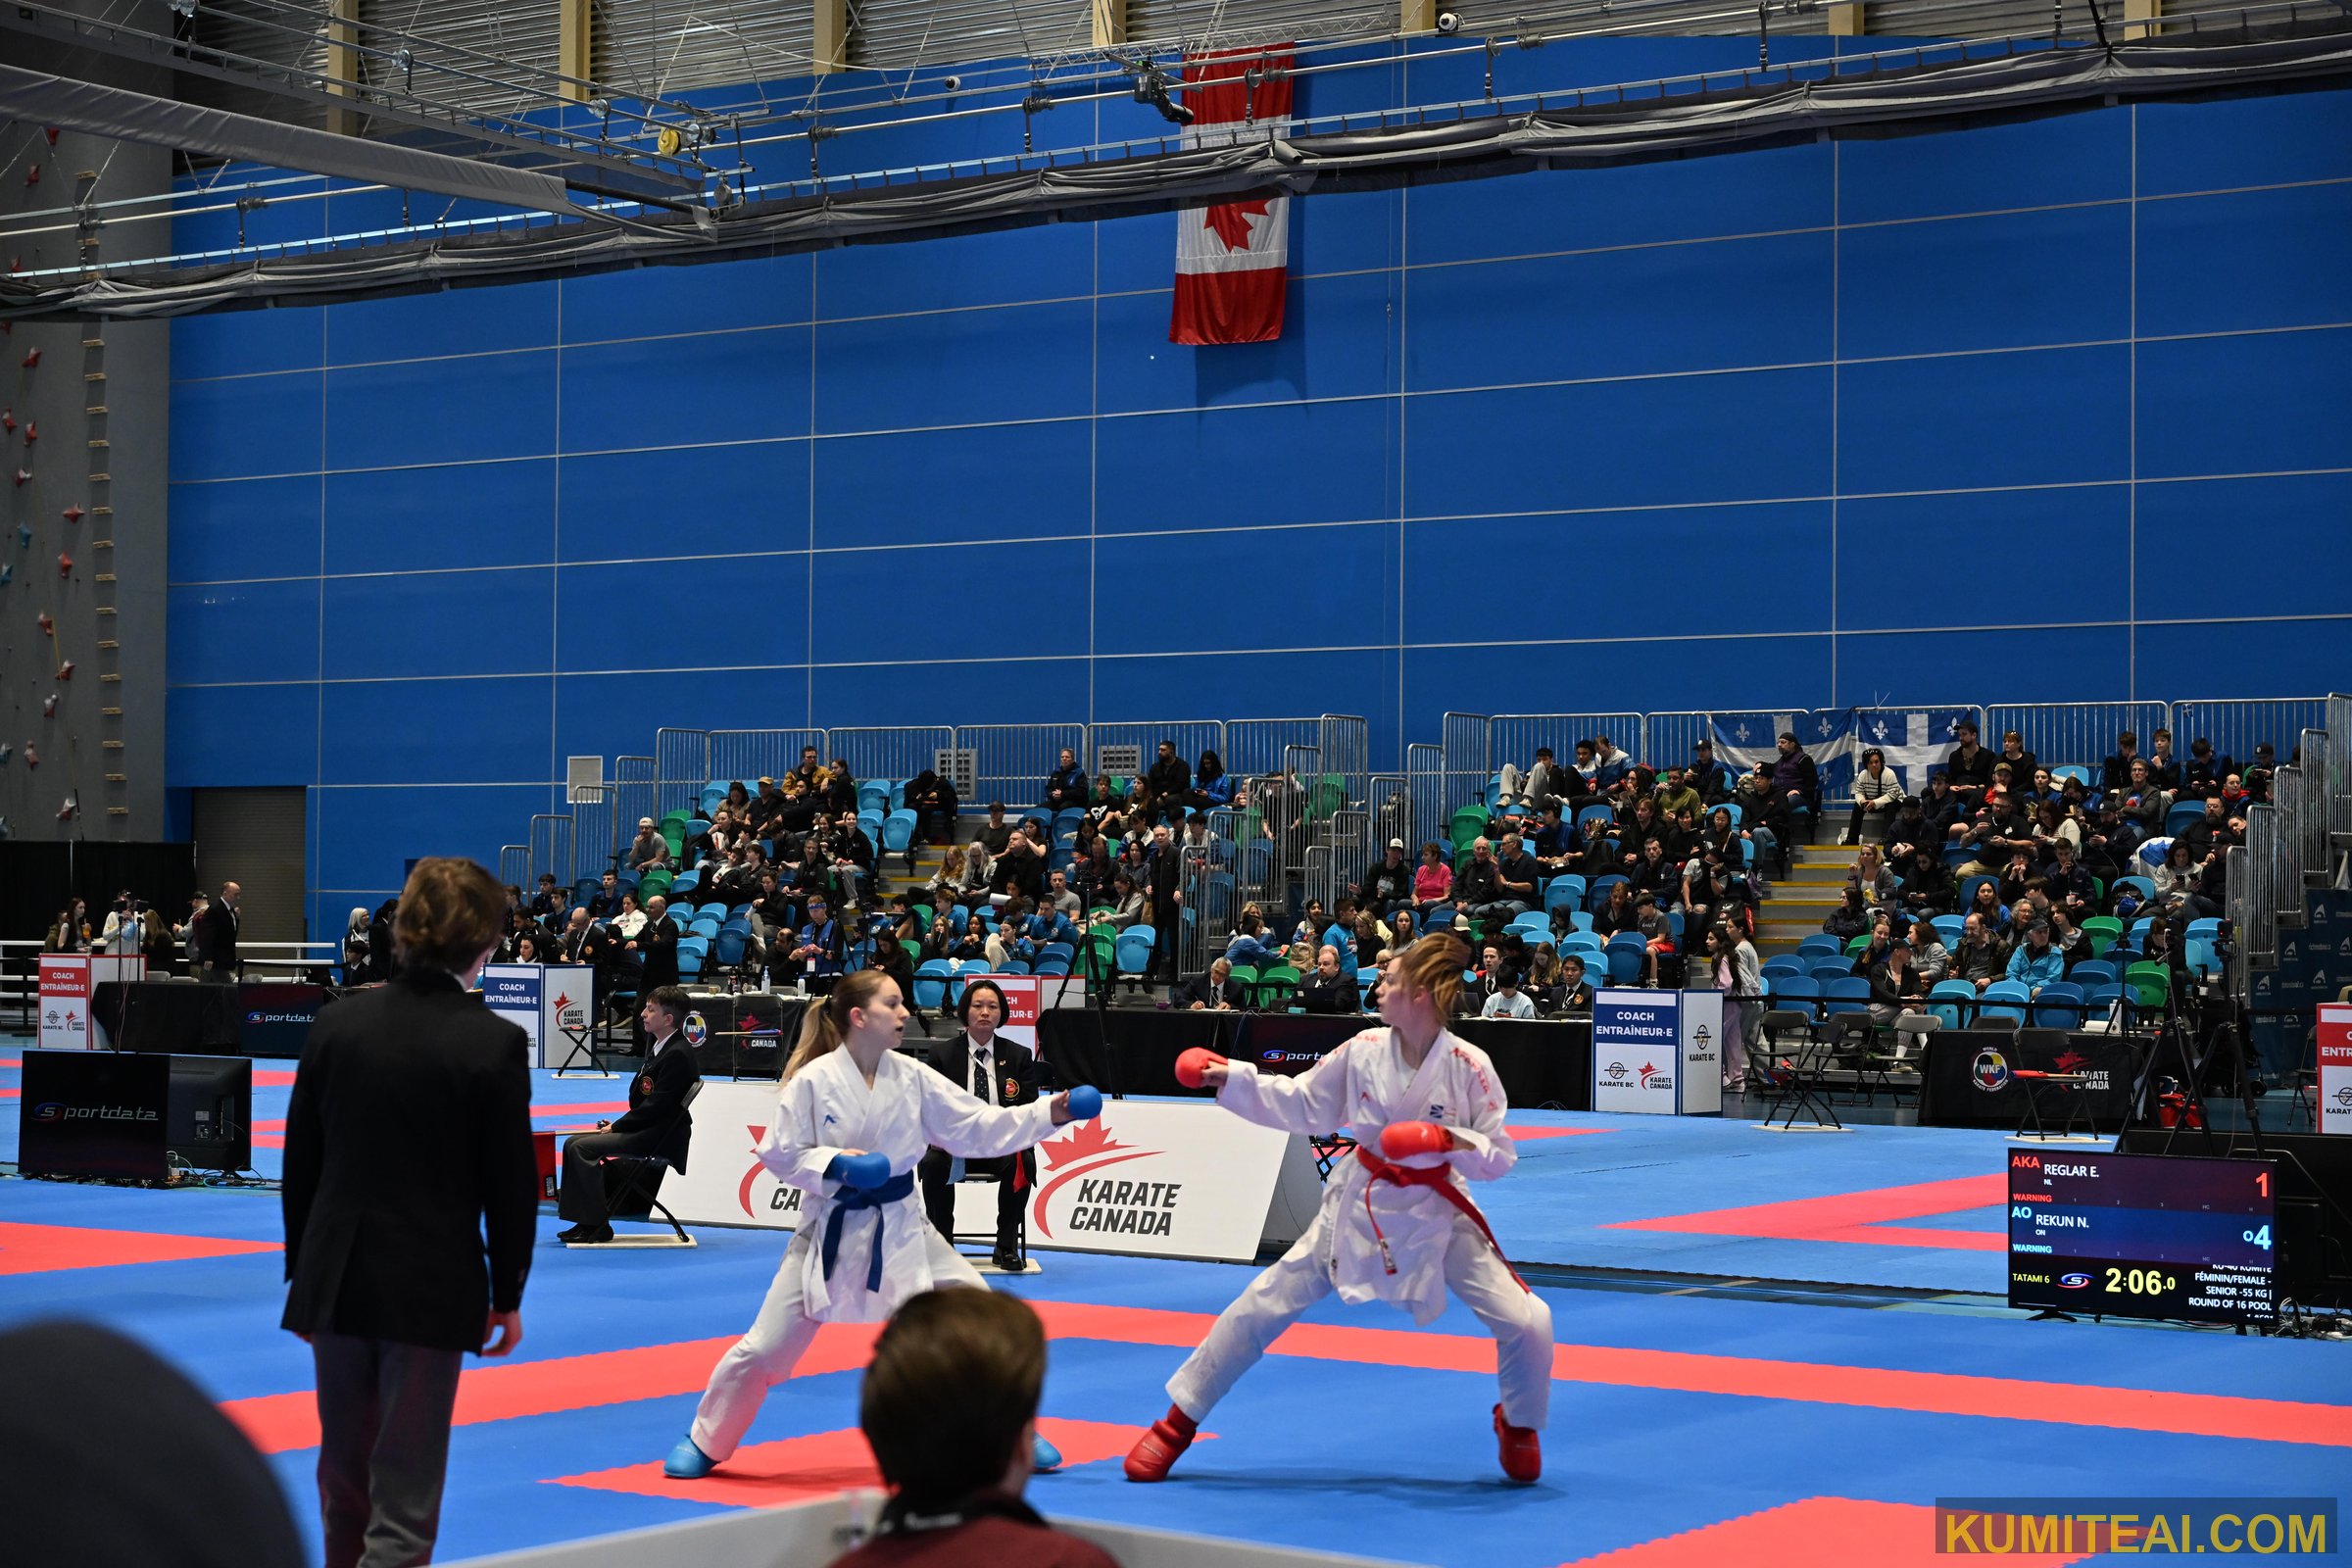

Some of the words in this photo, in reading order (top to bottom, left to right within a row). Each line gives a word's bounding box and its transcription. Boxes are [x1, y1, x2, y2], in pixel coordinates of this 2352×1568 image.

[499, 983, 525, 992] COACH
[1009, 1010, 1034, 1019] EUR·E
[1616, 1011, 1655, 1021] COACH
[751, 1039, 777, 1048] CANADA
[1689, 1054, 1707, 1062] KARATE
[2321, 1047, 2352, 1057] ENTR
[1979, 1064, 2001, 1074] WKF
[2011, 1155, 2040, 1168] AKA
[2043, 1163, 2087, 1177] REGLAR
[2089, 1165, 2100, 1178] E.
[2255, 1172, 2269, 1198] 1
[1077, 1179, 1183, 1208] KARATE
[2012, 1193, 2053, 1203] WARNING
[2011, 1206, 2033, 1219] AO
[1069, 1206, 1172, 1237] CANADA
[2035, 1214, 2075, 1227] REKUN
[2077, 1216, 2089, 1229] N.
[2012, 1243, 2053, 1254] WARNING
[2012, 1272, 2043, 1283] TATAMI
[2044, 1274, 2050, 1284] 6
[2194, 1271, 2266, 1286] FÉMININ/FEMALE
[2205, 1285, 2237, 1297] SENIOR
[2238, 1288, 2253, 1298] -55
[2255, 1289, 2268, 1298] KG
[2188, 1297, 2221, 1307] ROUND
[2222, 1299, 2234, 1308] OF
[2236, 1300, 2247, 1309] 16
[2248, 1300, 2273, 1311] POOL
